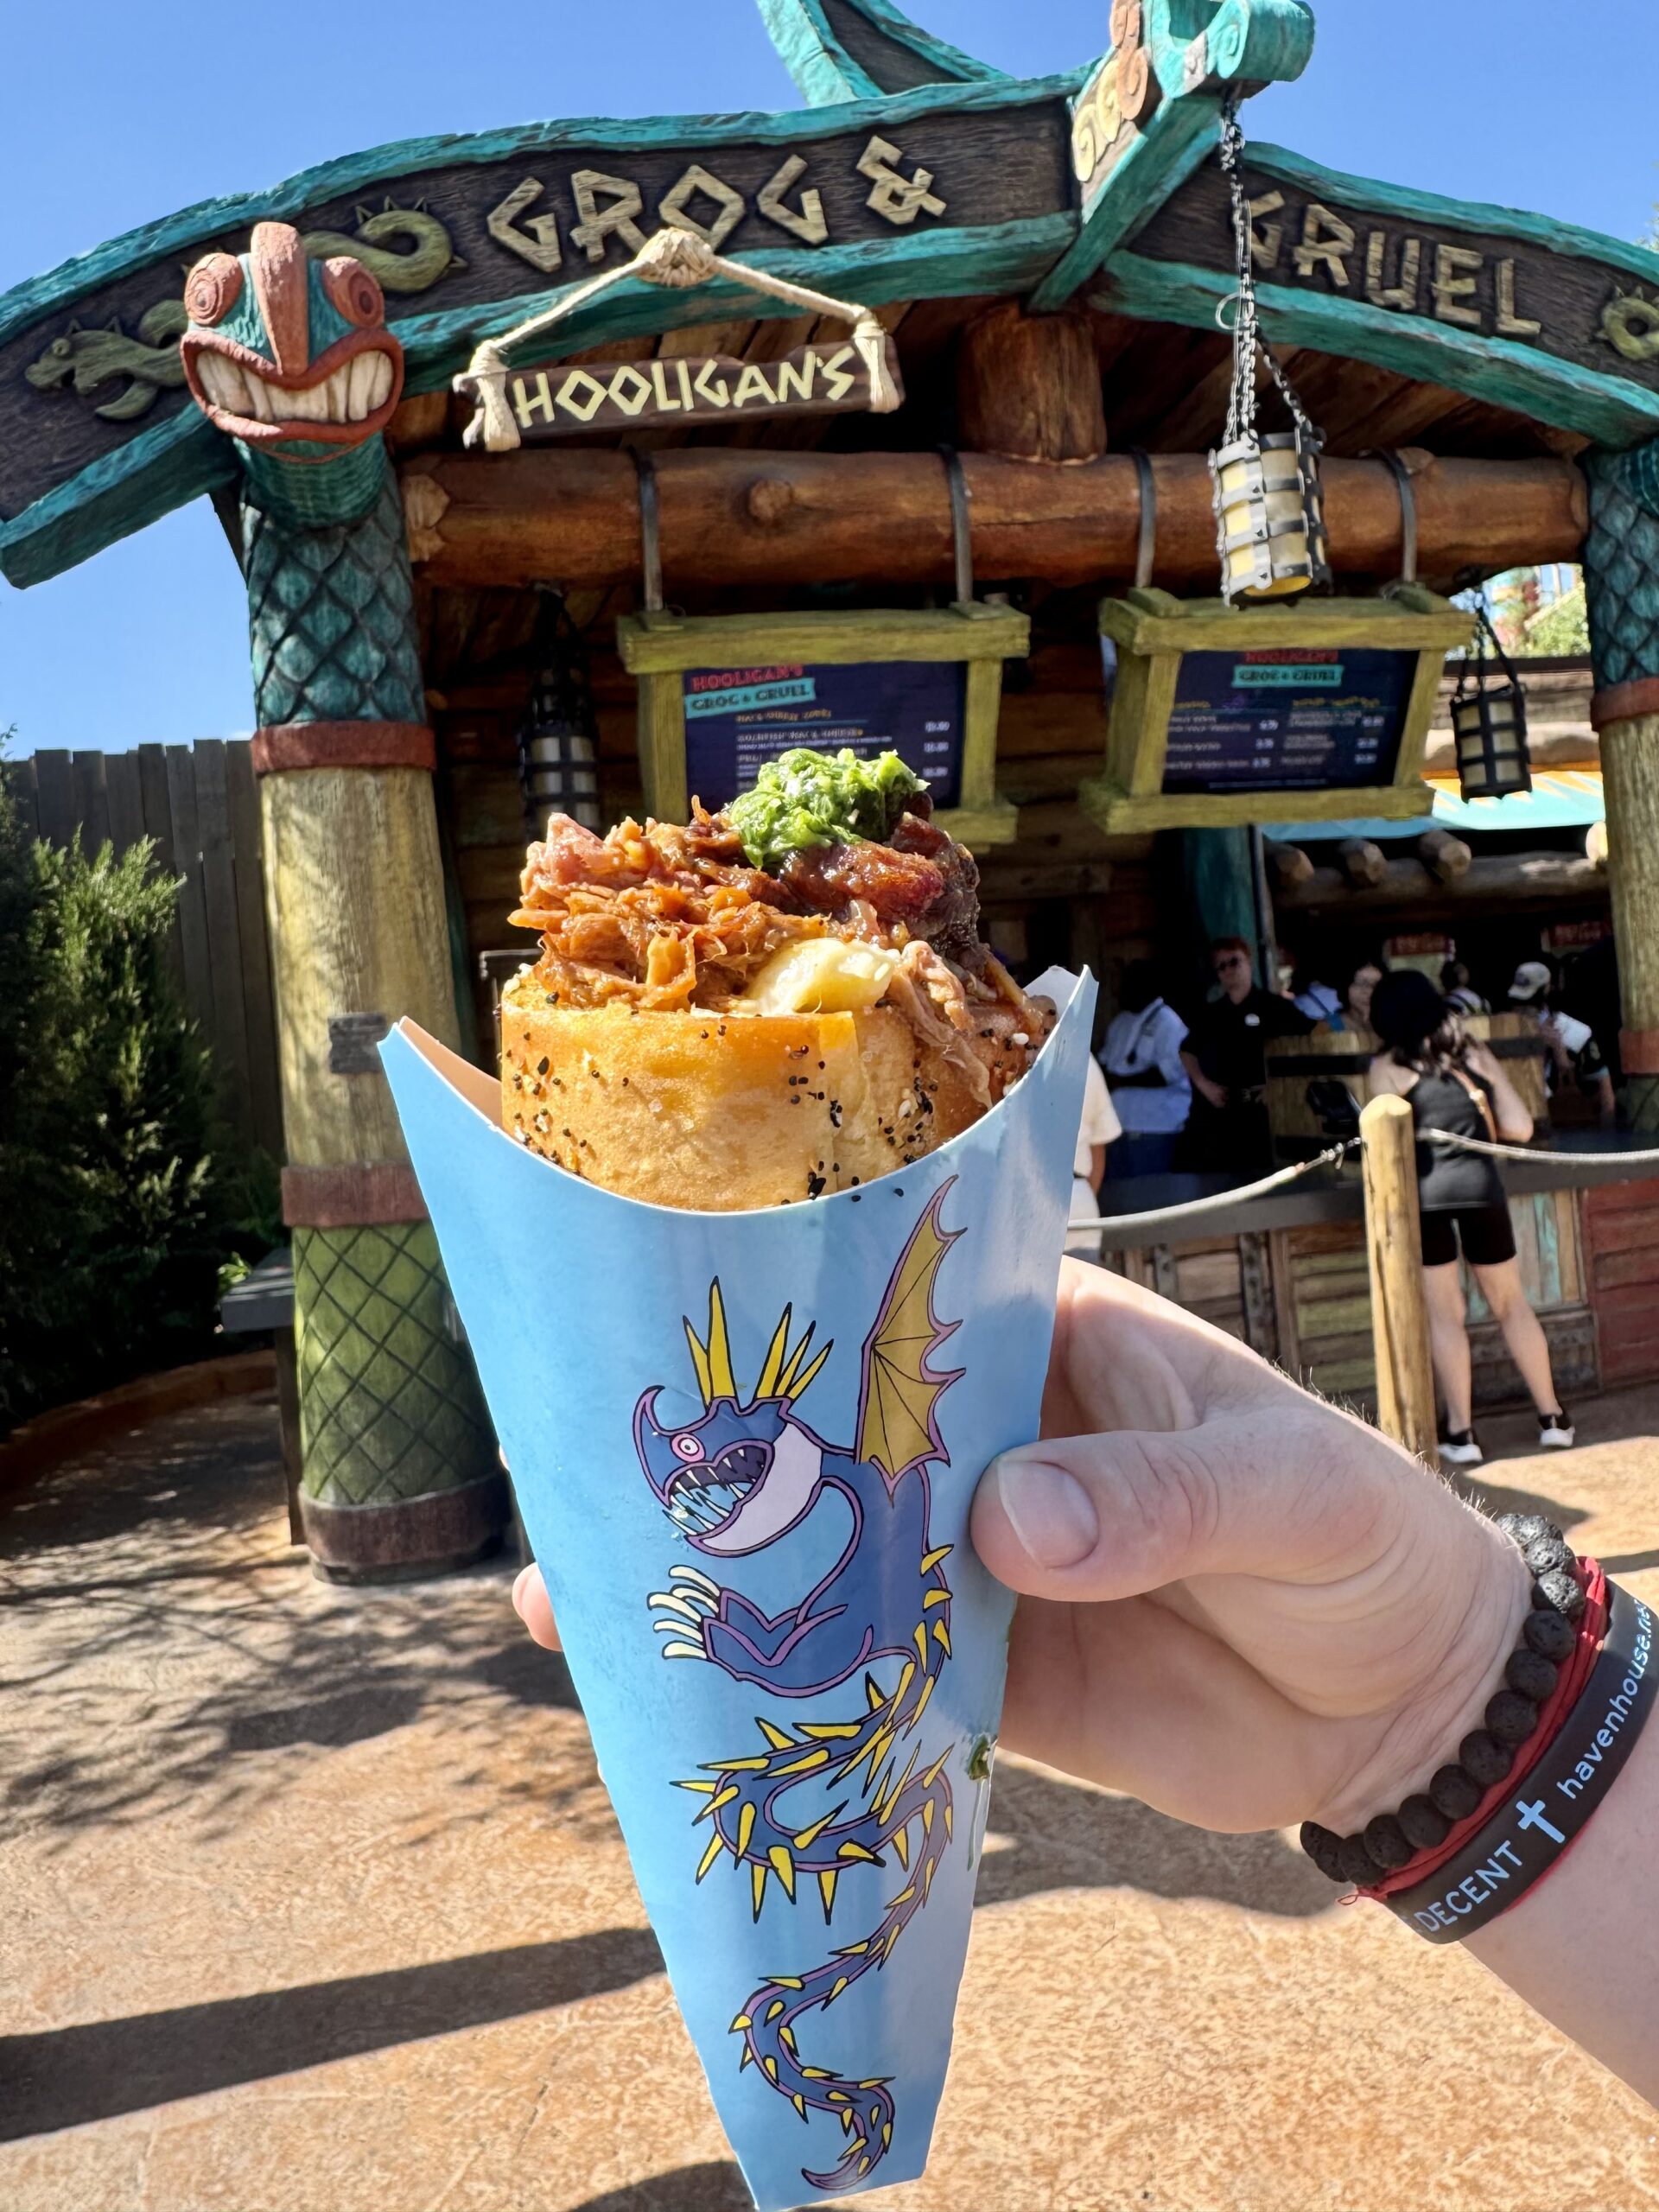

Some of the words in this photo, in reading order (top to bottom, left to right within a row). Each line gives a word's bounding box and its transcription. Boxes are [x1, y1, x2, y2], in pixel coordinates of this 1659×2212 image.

[486, 154, 830, 272] GROG
[855, 135, 947, 225] &
[512, 346, 856, 429] HOOLIGAN'S
[1413, 1840, 1523, 1932] DECENT
